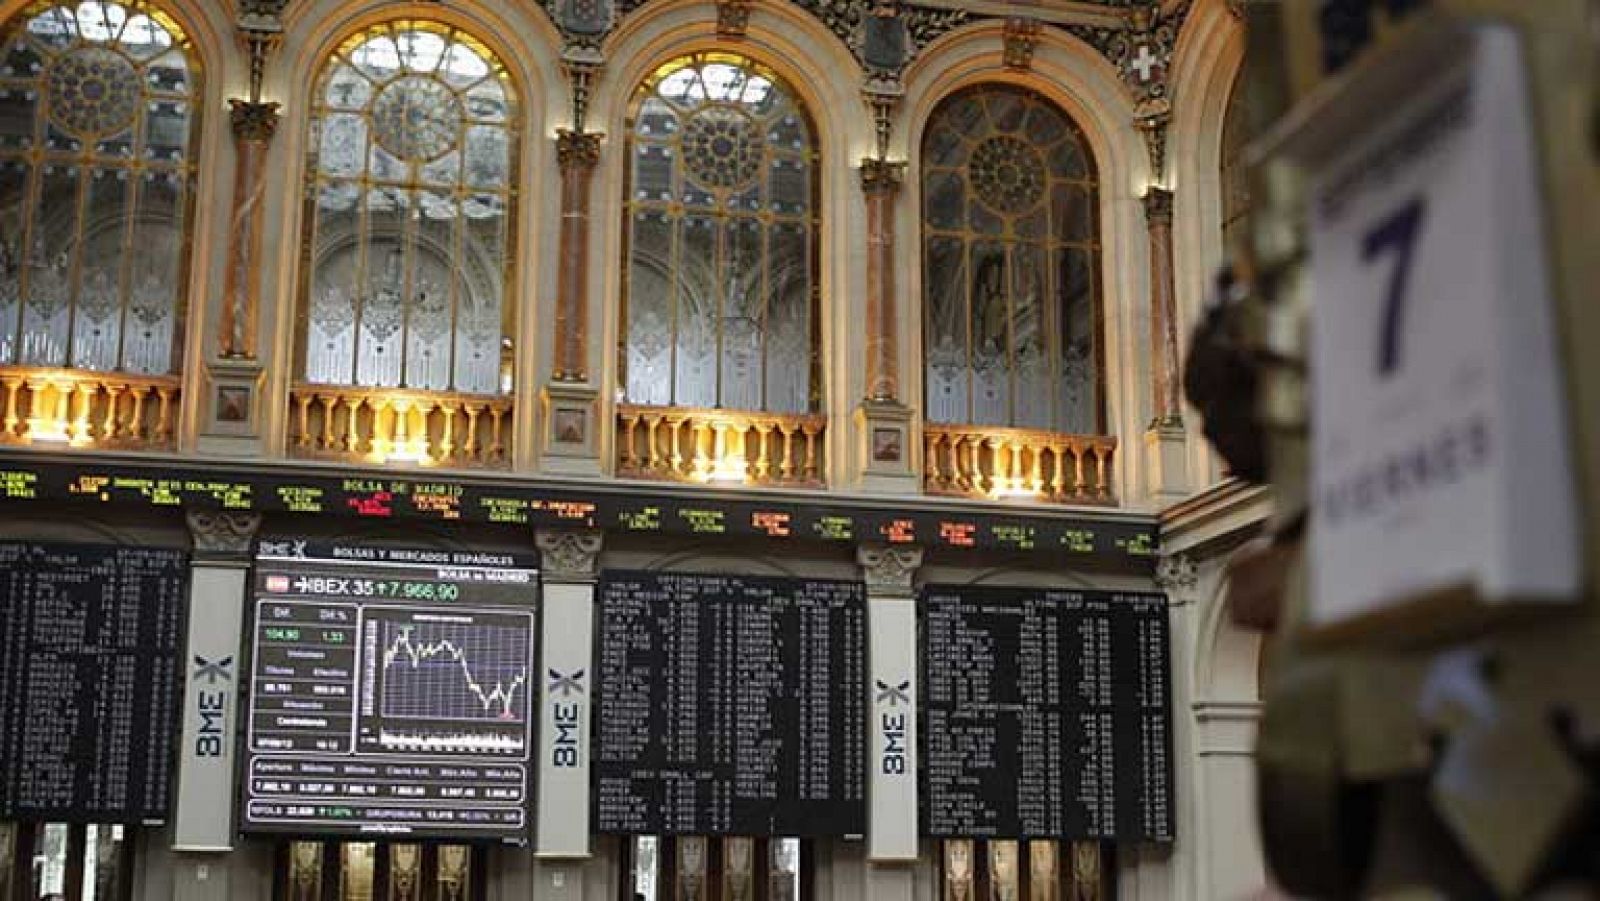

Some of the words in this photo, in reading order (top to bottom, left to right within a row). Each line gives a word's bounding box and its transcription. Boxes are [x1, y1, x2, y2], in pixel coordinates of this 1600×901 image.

[1358, 192, 1428, 376] 7
[343, 480, 382, 493] BOLSA
[391, 482, 407, 494] DE
[415, 484, 463, 496] MADRID
[352, 579, 374, 596] 35
[388, 550, 449, 562] MERCADOS
[196, 690, 224, 757] BME
[553, 702, 578, 768] BME
[882, 712, 905, 775] BME
